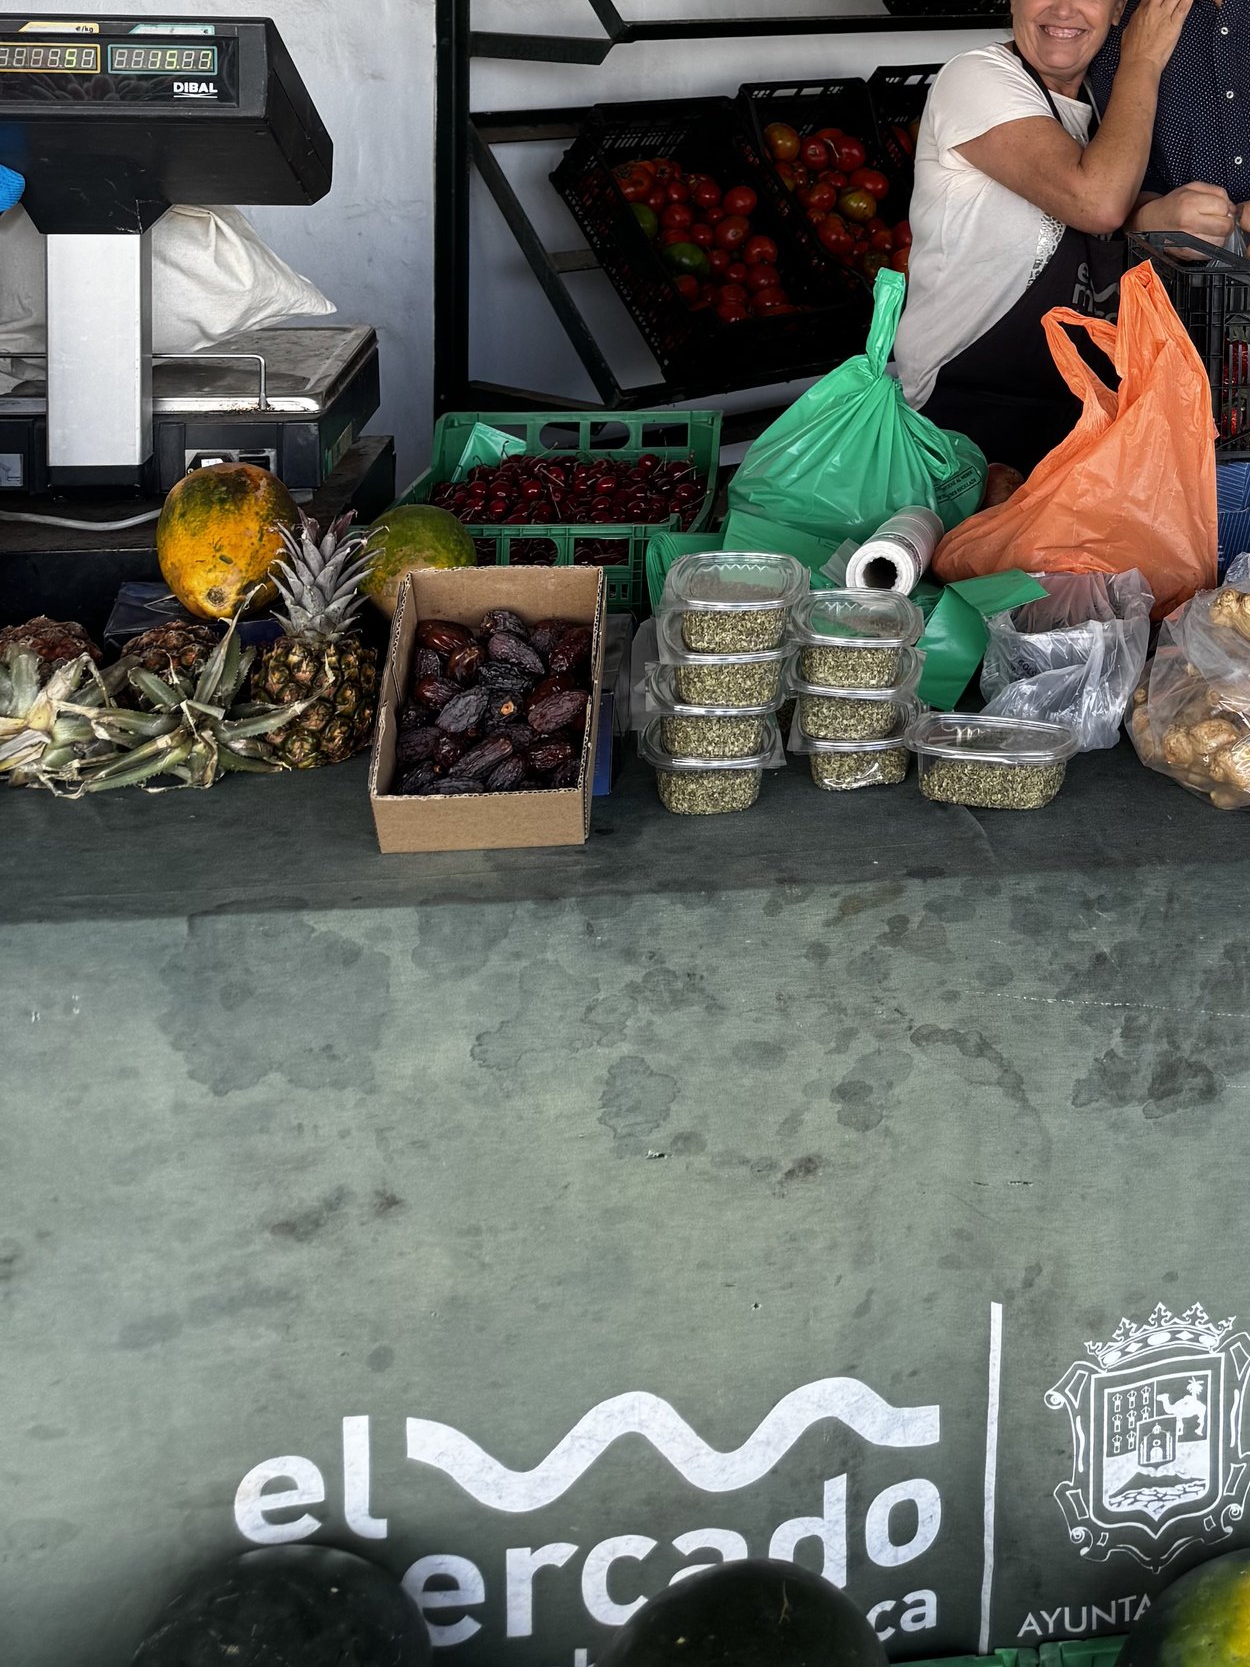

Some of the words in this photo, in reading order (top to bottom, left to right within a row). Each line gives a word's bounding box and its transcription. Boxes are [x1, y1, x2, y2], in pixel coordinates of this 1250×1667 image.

[173, 82, 218, 93] DIBAL
[234, 1415, 387, 1544] el
[402, 1473, 942, 1647] ercado
[1017, 1593, 1151, 1638] AYUNTA
